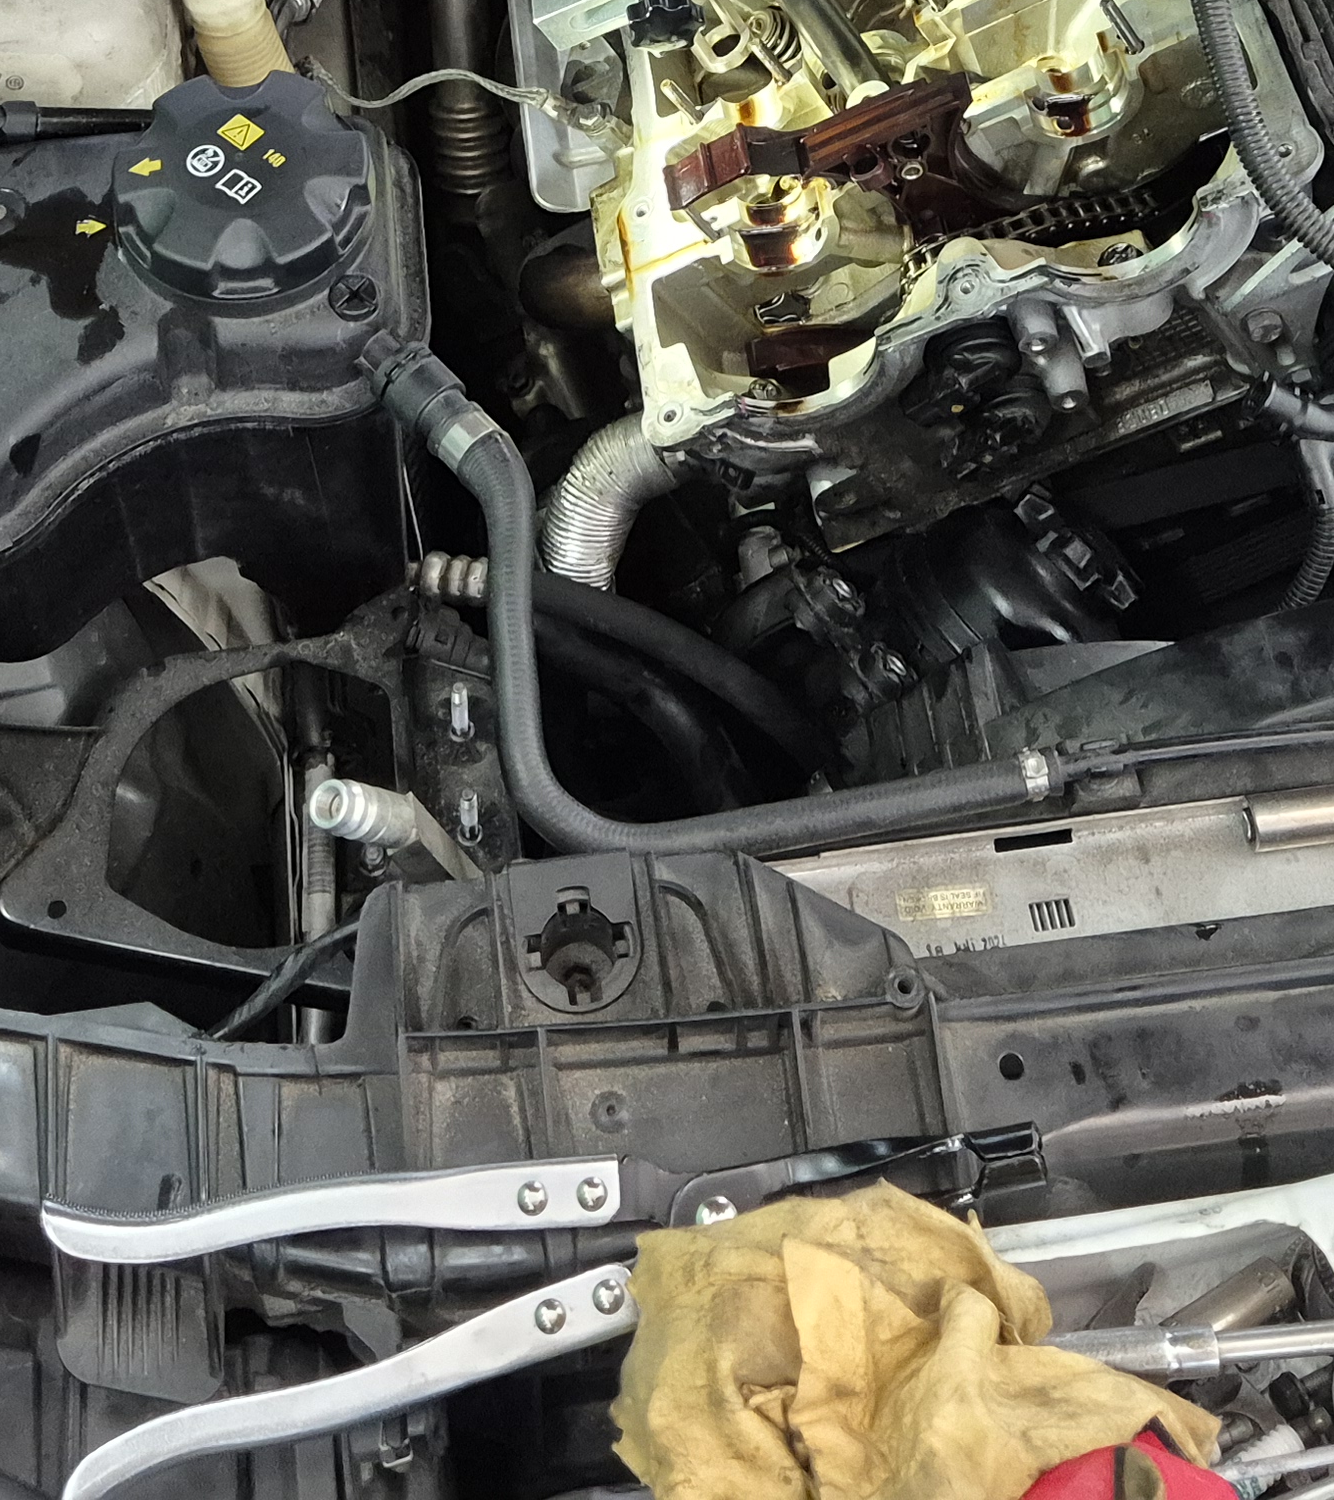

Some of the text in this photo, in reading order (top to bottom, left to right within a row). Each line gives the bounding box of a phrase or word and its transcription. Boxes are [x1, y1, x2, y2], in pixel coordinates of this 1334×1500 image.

[262, 148, 287, 168] 140
[940, 893, 949, 901] IS
[950, 892, 972, 900] SEAL
[931, 899, 984, 912] WARRANTY
